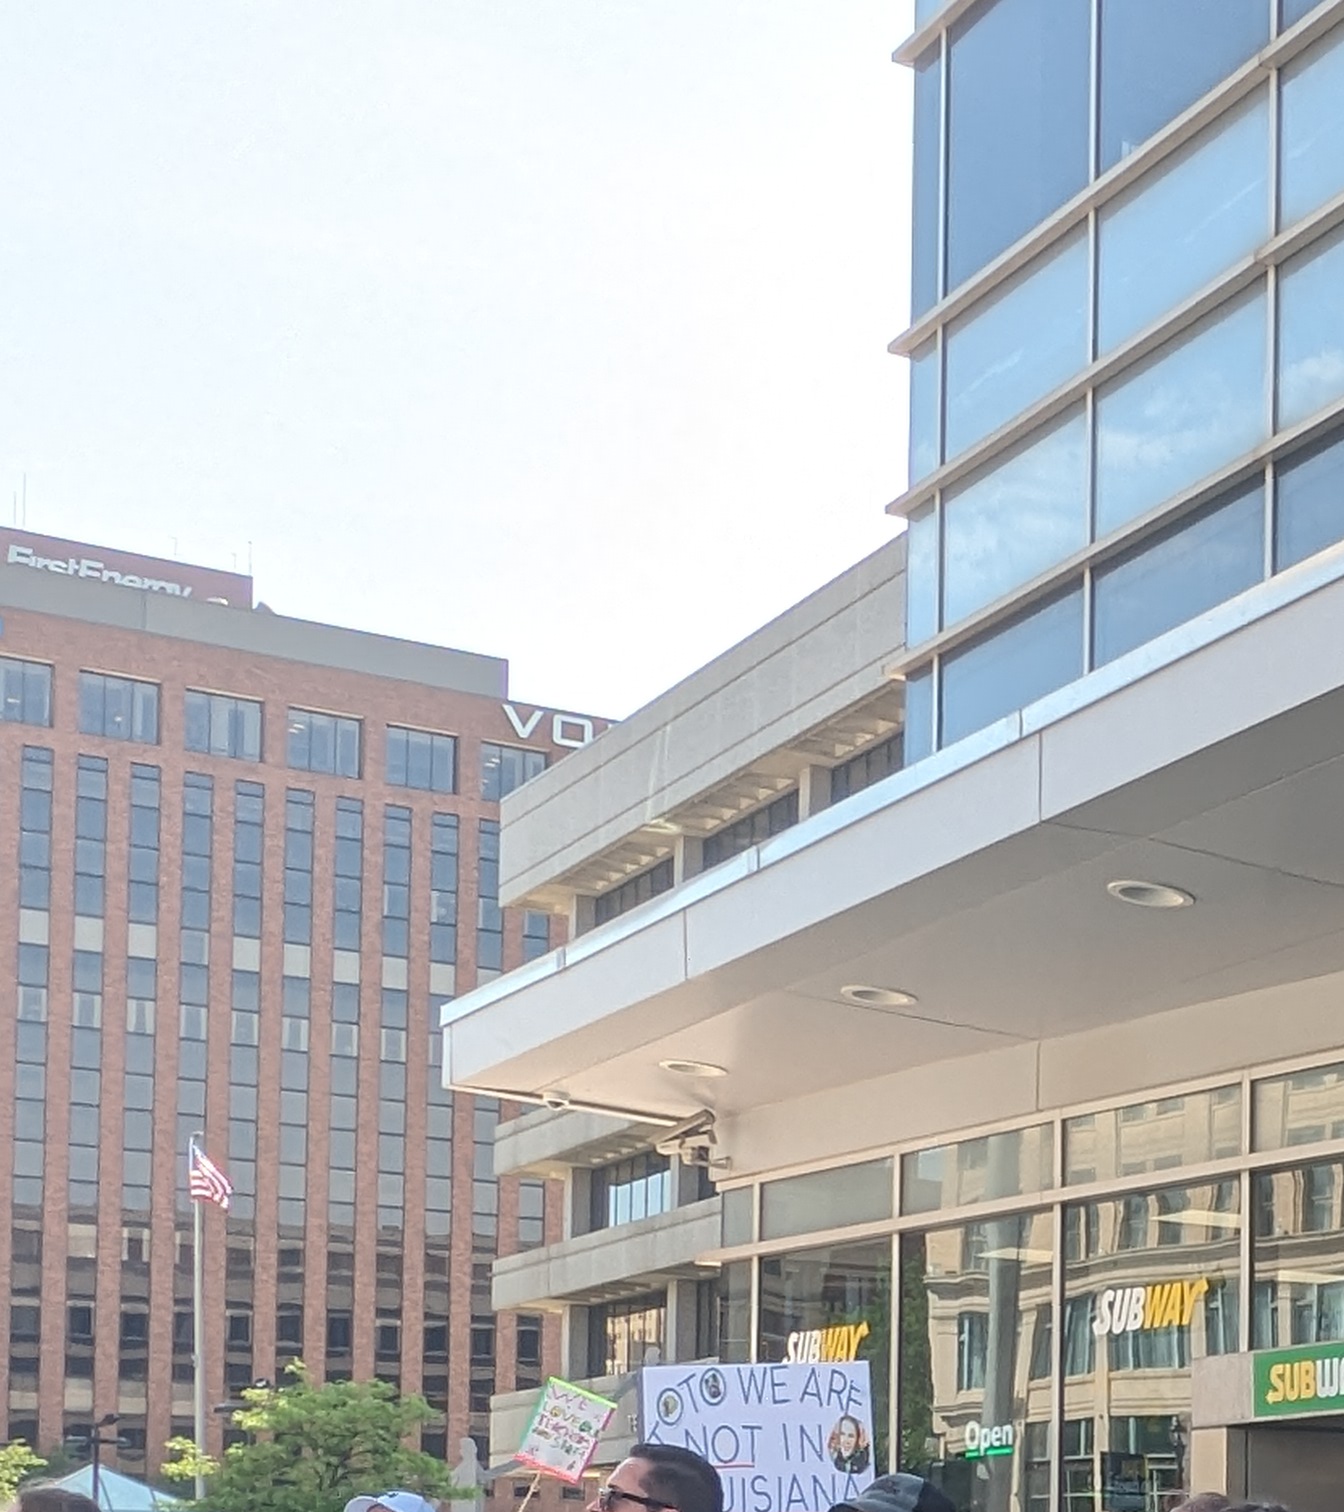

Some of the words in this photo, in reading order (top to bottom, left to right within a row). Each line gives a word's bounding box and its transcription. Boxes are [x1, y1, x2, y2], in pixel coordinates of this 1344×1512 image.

[502, 704, 612, 748] VO
[1093, 1278, 1209, 1337] SUBWAY
[782, 1321, 871, 1364] SUBWAY
[737, 1365, 791, 1405] WE
[800, 1366, 863, 1416] ARE
[685, 1424, 762, 1464] NOT
[782, 1423, 824, 1463] IN
[965, 1420, 1014, 1457] Open
